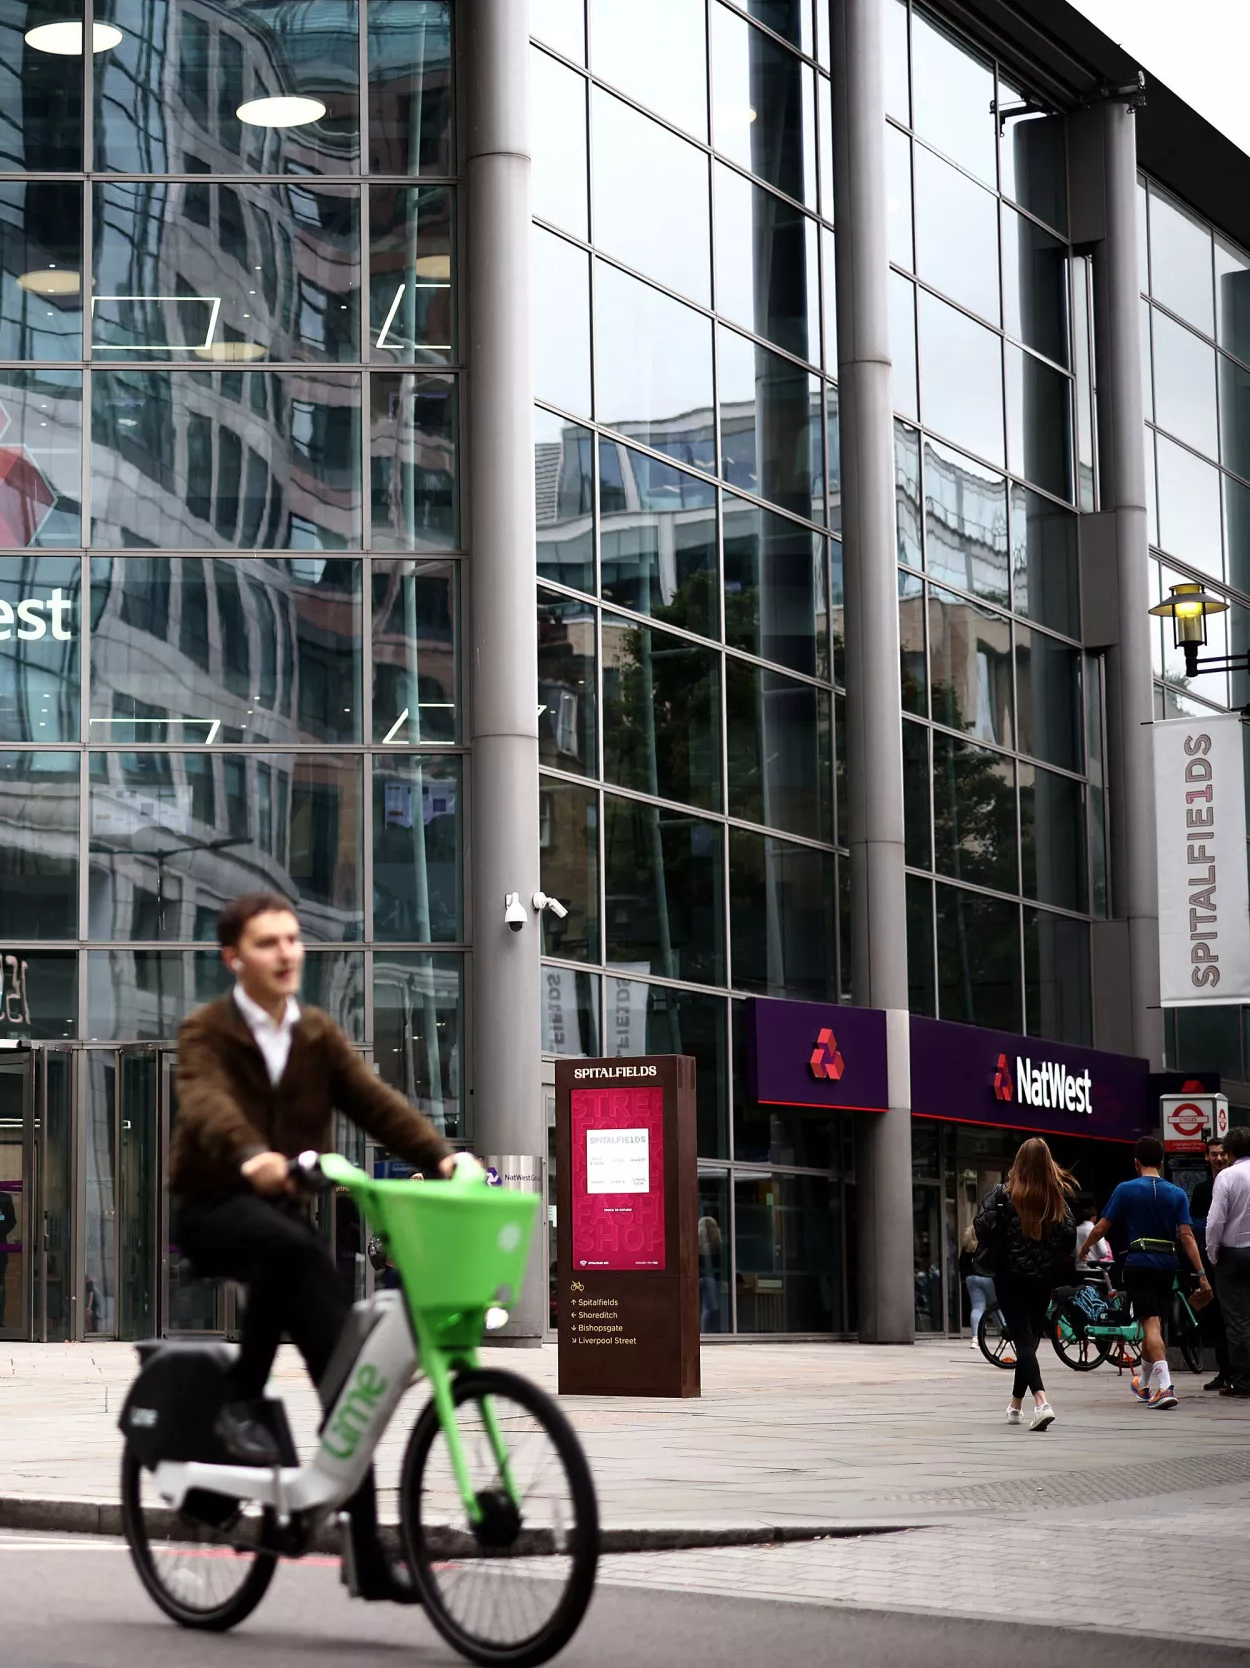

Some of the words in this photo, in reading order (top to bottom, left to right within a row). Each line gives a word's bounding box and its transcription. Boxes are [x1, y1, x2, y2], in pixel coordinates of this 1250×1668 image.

[573, 1065, 658, 1079] SPITALFIELDS
[1016, 1056, 1093, 1114] NatWest
[504, 1173, 531, 1182] NatWest
[578, 1298, 619, 1307] Spitalfields
[578, 1311, 618, 1319] Shoreditch
[578, 1324, 623, 1333] Bishopsgate
[578, 1337, 613, 1345] Liverpool
[614, 1337, 637, 1345] Street
